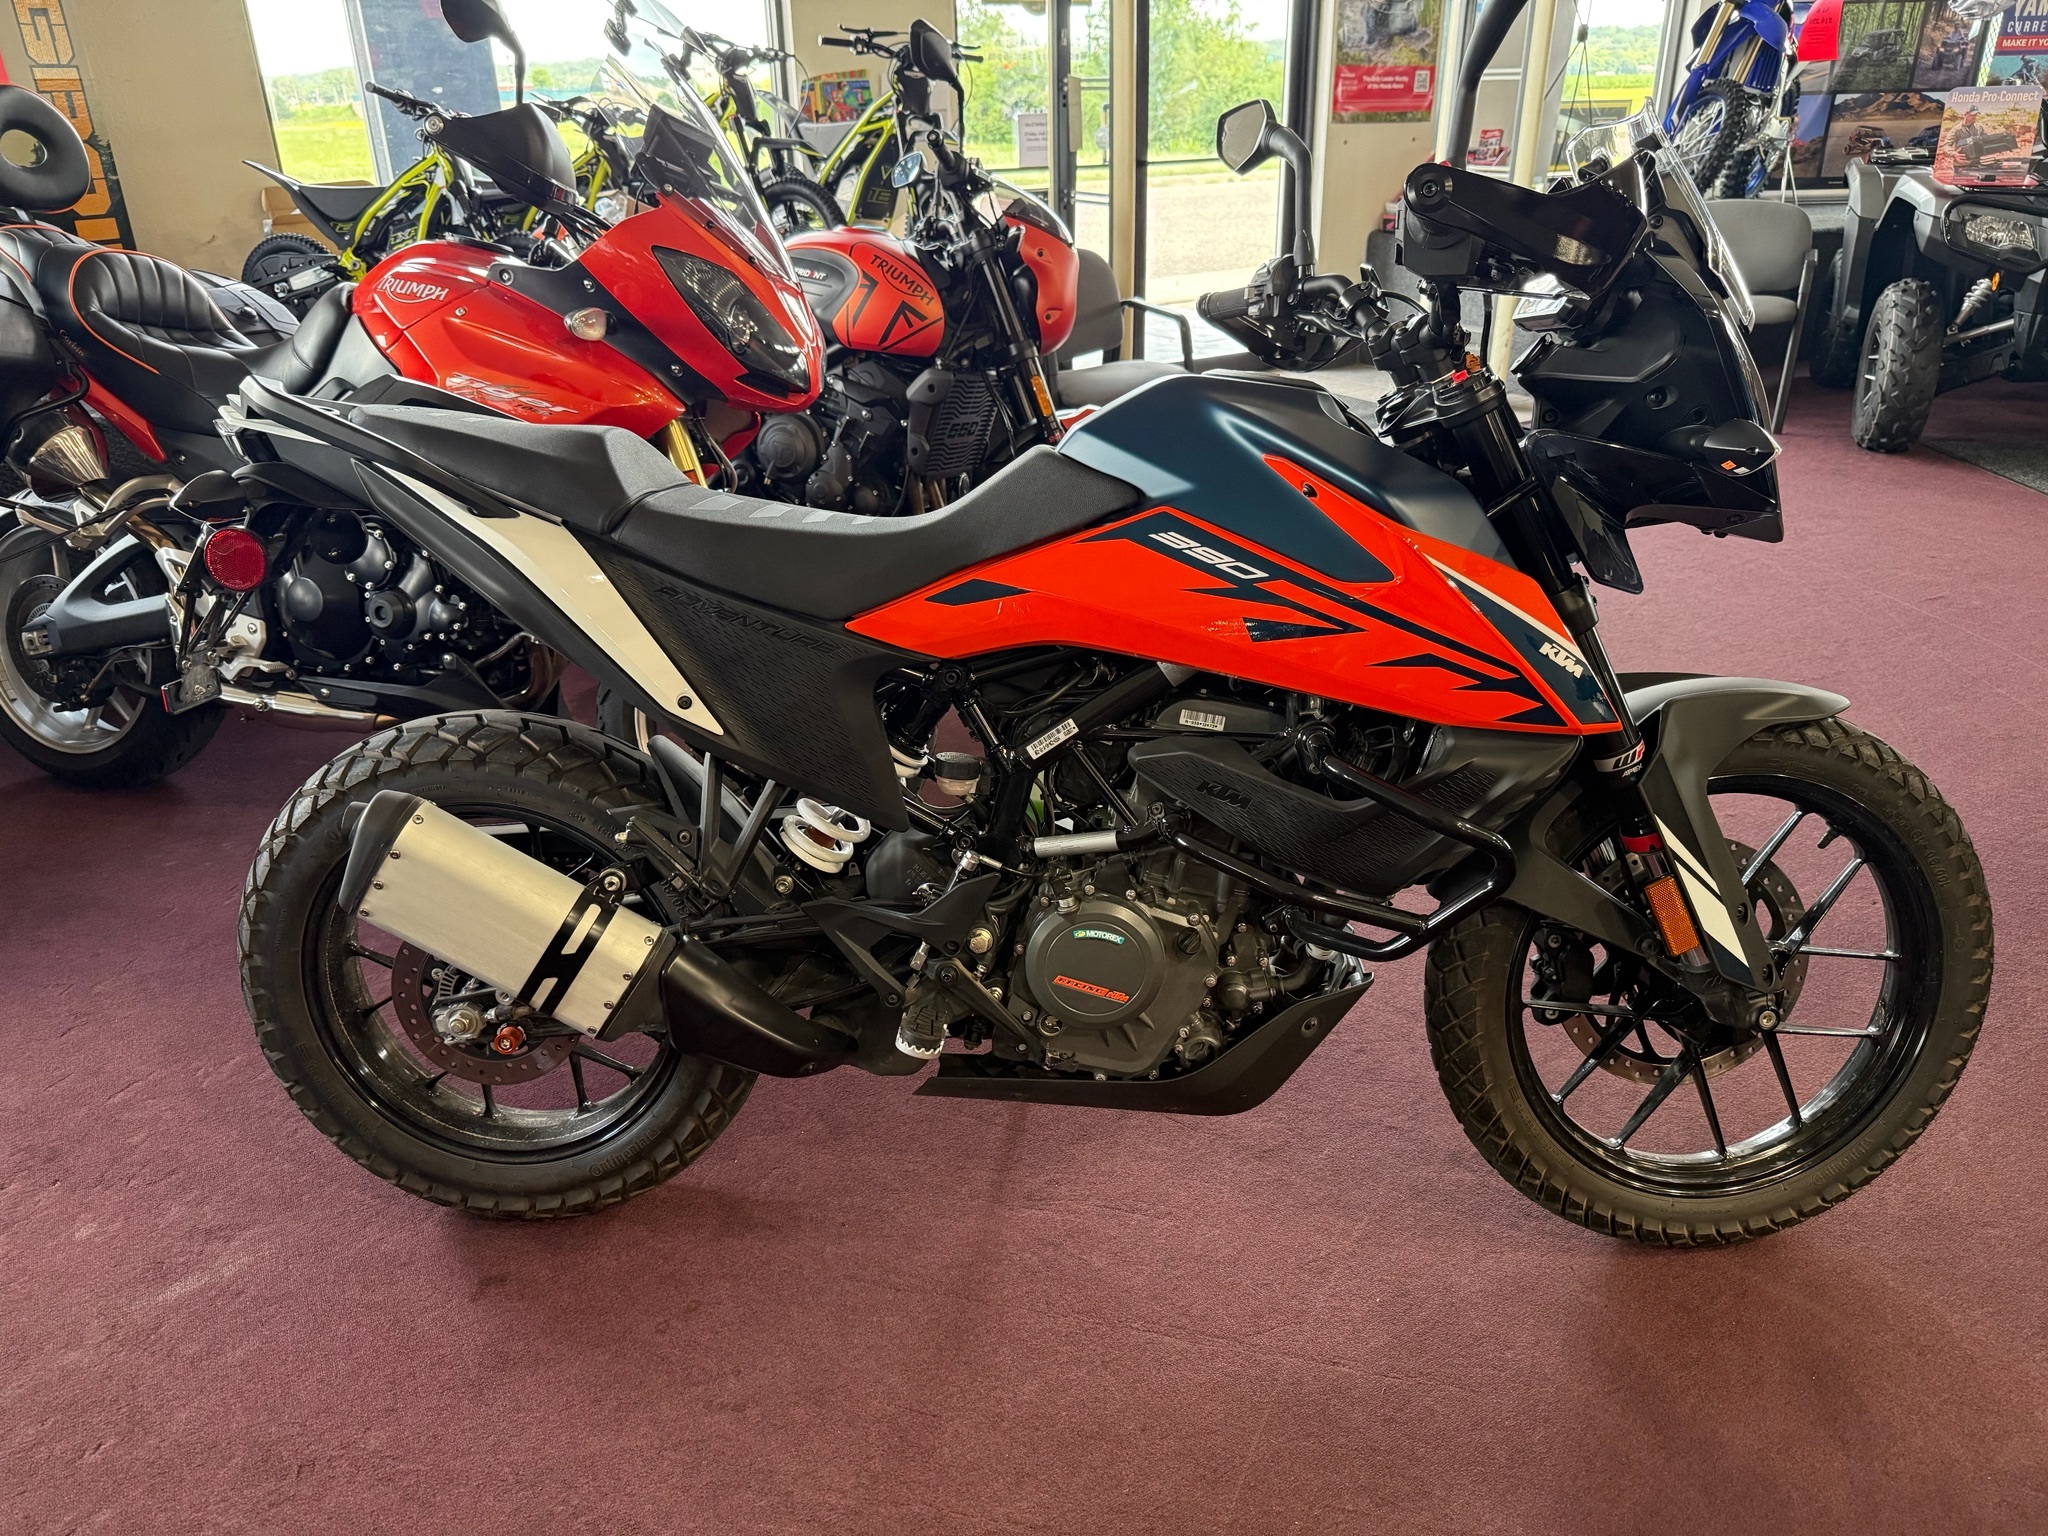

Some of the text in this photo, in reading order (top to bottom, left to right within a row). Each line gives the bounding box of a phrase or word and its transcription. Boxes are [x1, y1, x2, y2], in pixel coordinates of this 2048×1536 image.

[2002, 39, 2027, 47] MAKE
[2028, 38, 2037, 46] IT
[1952, 91, 1980, 103] Honda
[377, 275, 449, 302] TRIUMPH
[869, 254, 934, 307] TRIUMPH
[1148, 531, 1270, 579] 390
[655, 585, 843, 657] ADVENTURE
[1538, 641, 1584, 679] KTM
[1621, 763, 1643, 778] APEX
[1196, 780, 1254, 811] KTM
[1086, 930, 1121, 944] MOTOREX
[1058, 977, 1104, 995] RACING
[589, 1132, 652, 1177] Continental
